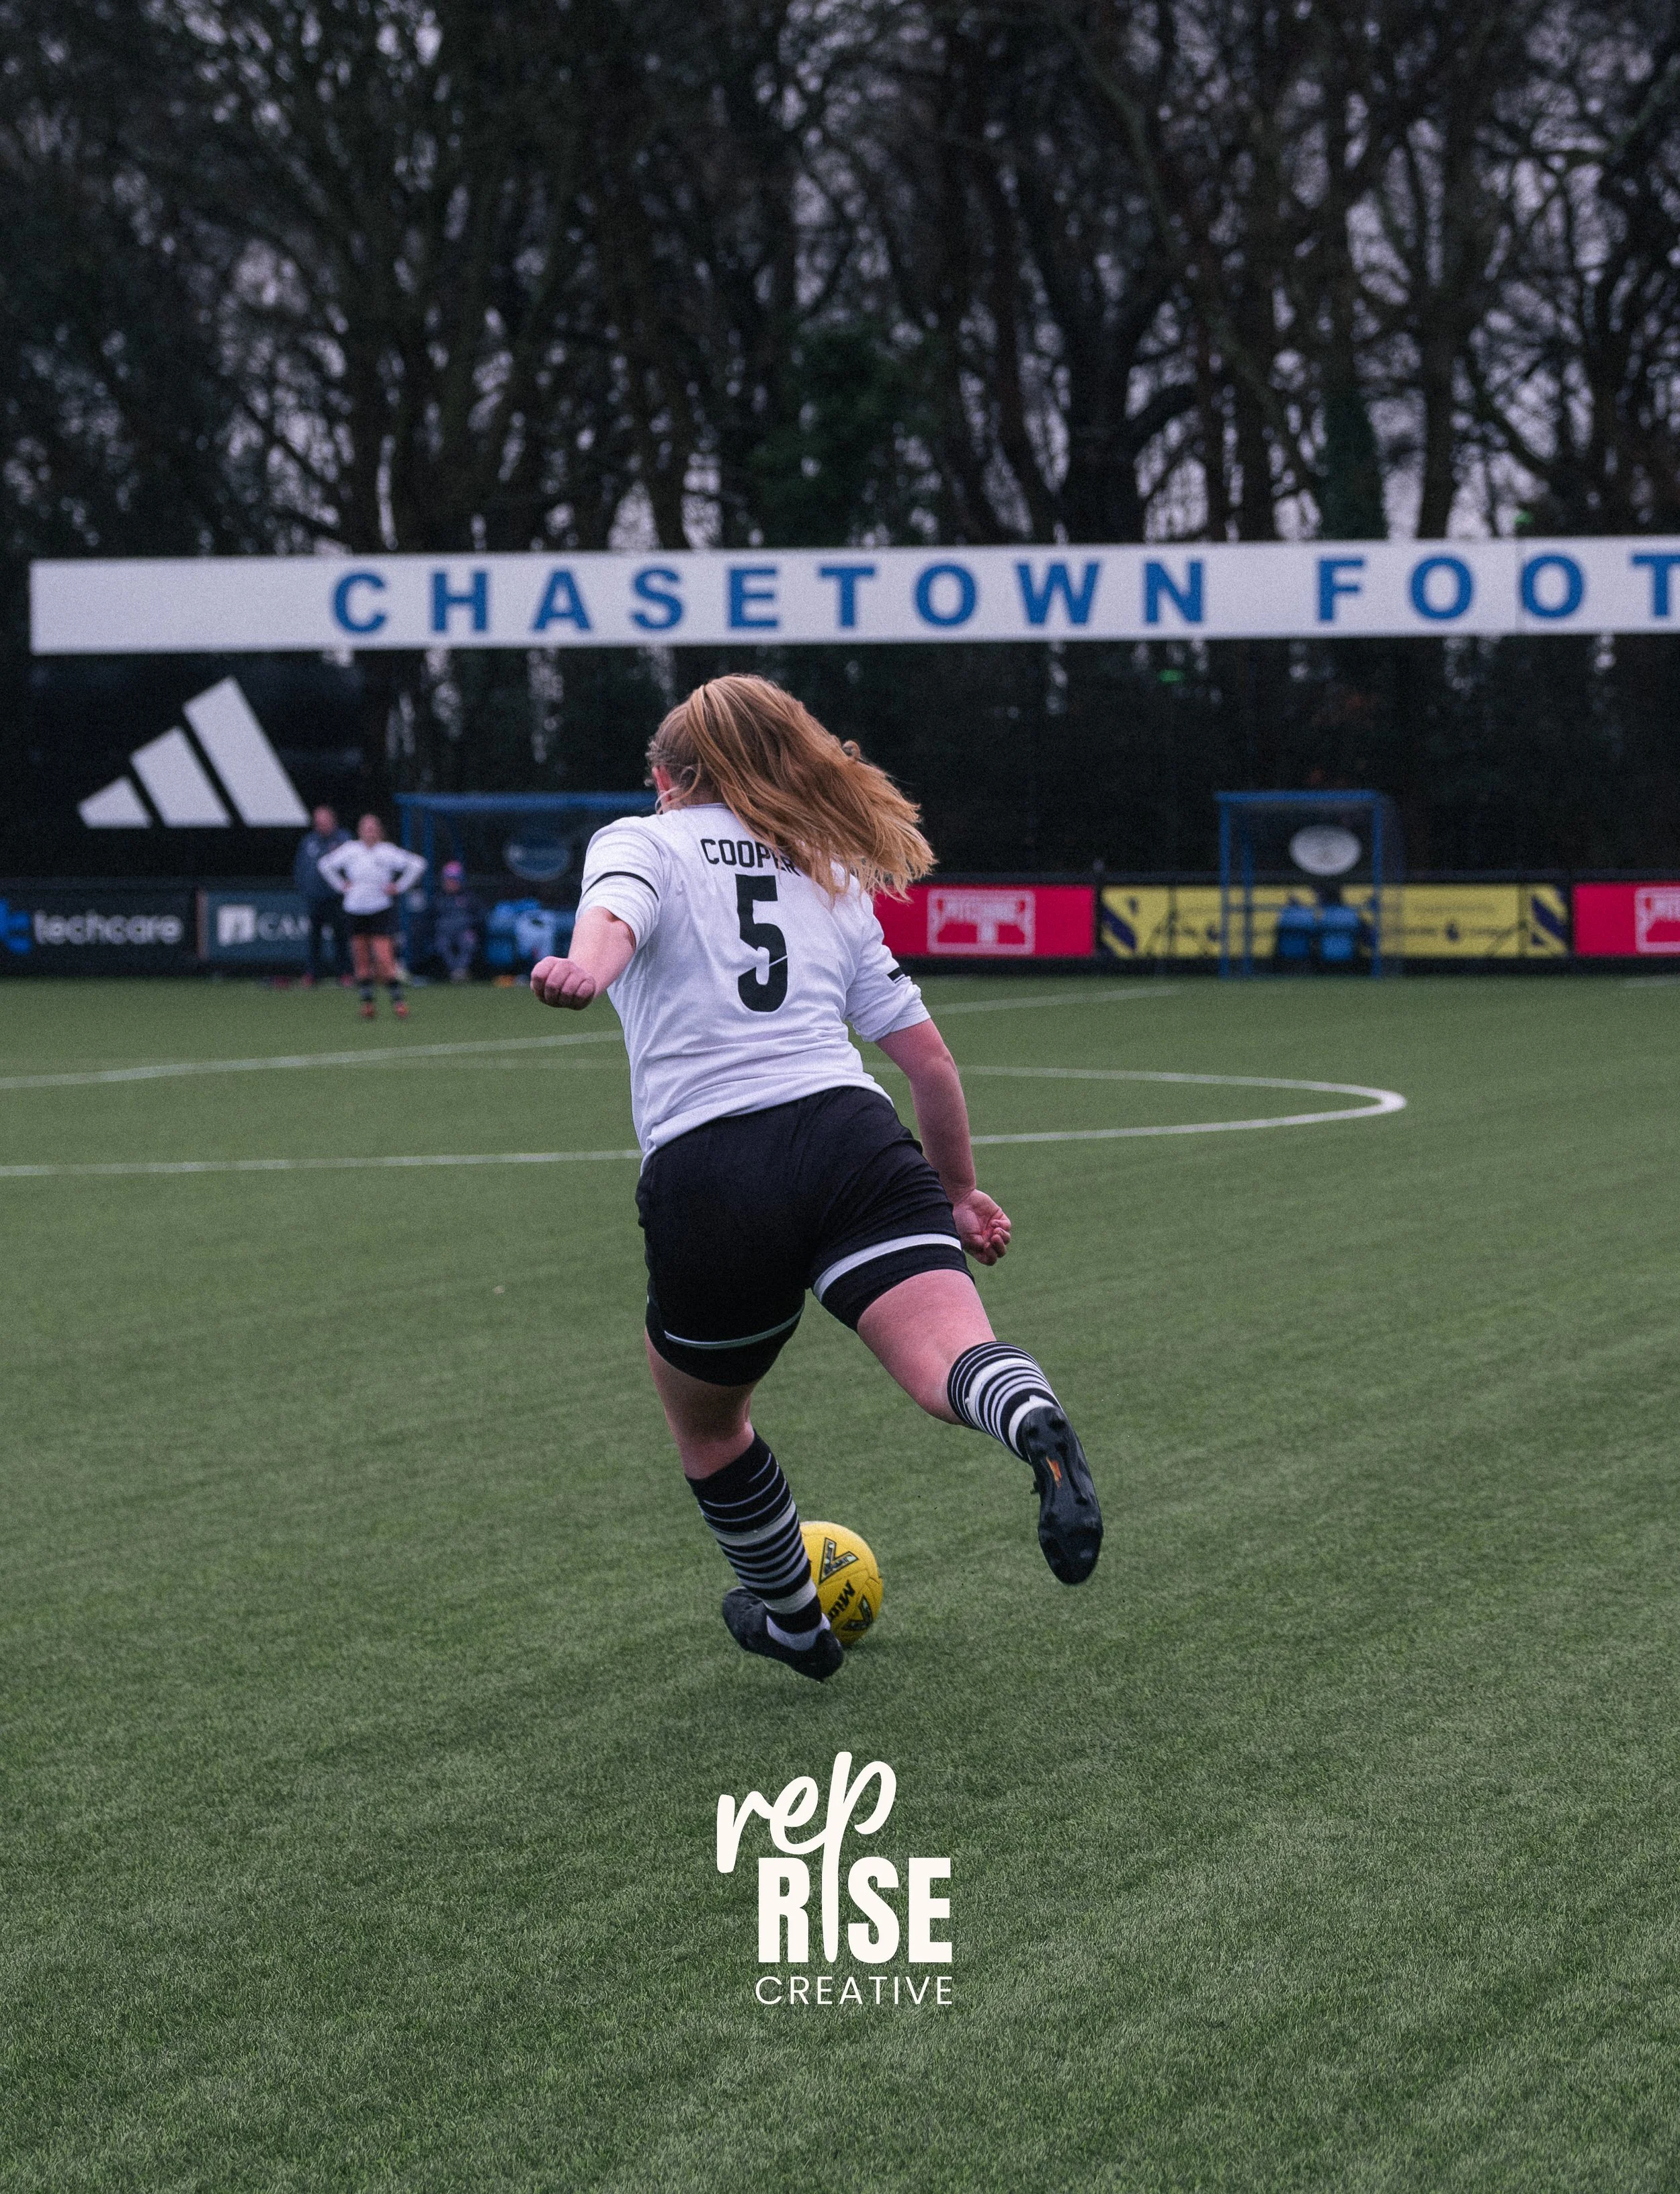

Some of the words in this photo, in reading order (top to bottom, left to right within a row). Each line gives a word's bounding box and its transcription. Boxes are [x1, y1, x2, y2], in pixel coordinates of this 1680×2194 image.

[329, 558, 1207, 637] CHASETOWN
[1315, 550, 1680, 624] FOOT
[735, 873, 788, 1013] 5
